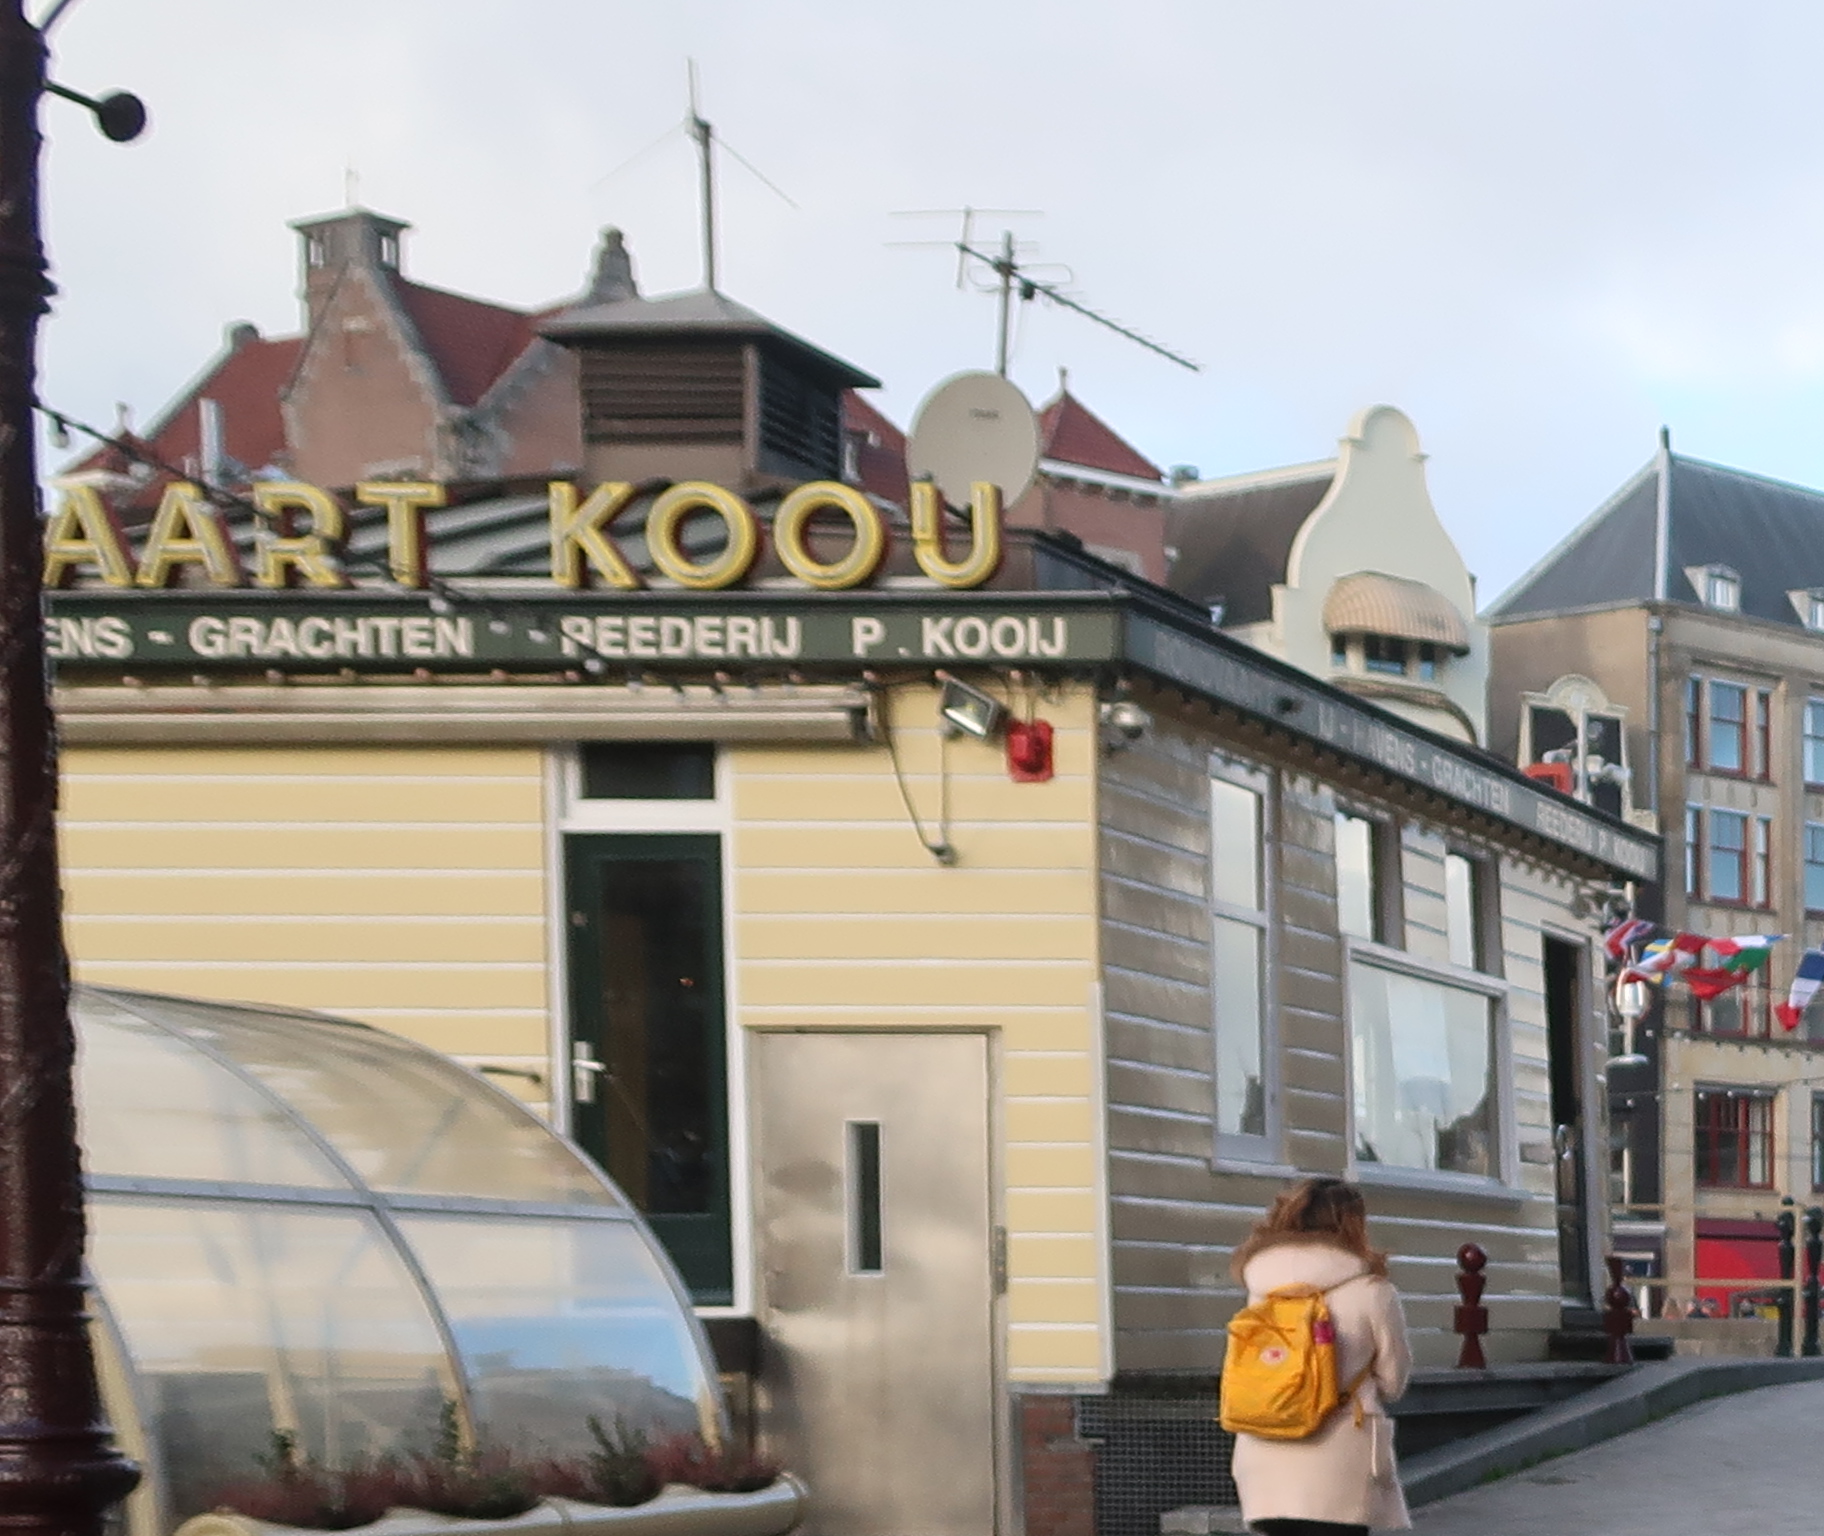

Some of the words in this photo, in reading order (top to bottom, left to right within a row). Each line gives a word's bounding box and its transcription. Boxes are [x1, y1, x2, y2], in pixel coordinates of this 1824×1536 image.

[189, 616, 473, 658] GRACHTEN
[560, 615, 799, 658] REEDERIJ
[921, 616, 1067, 658] KOOIJ
